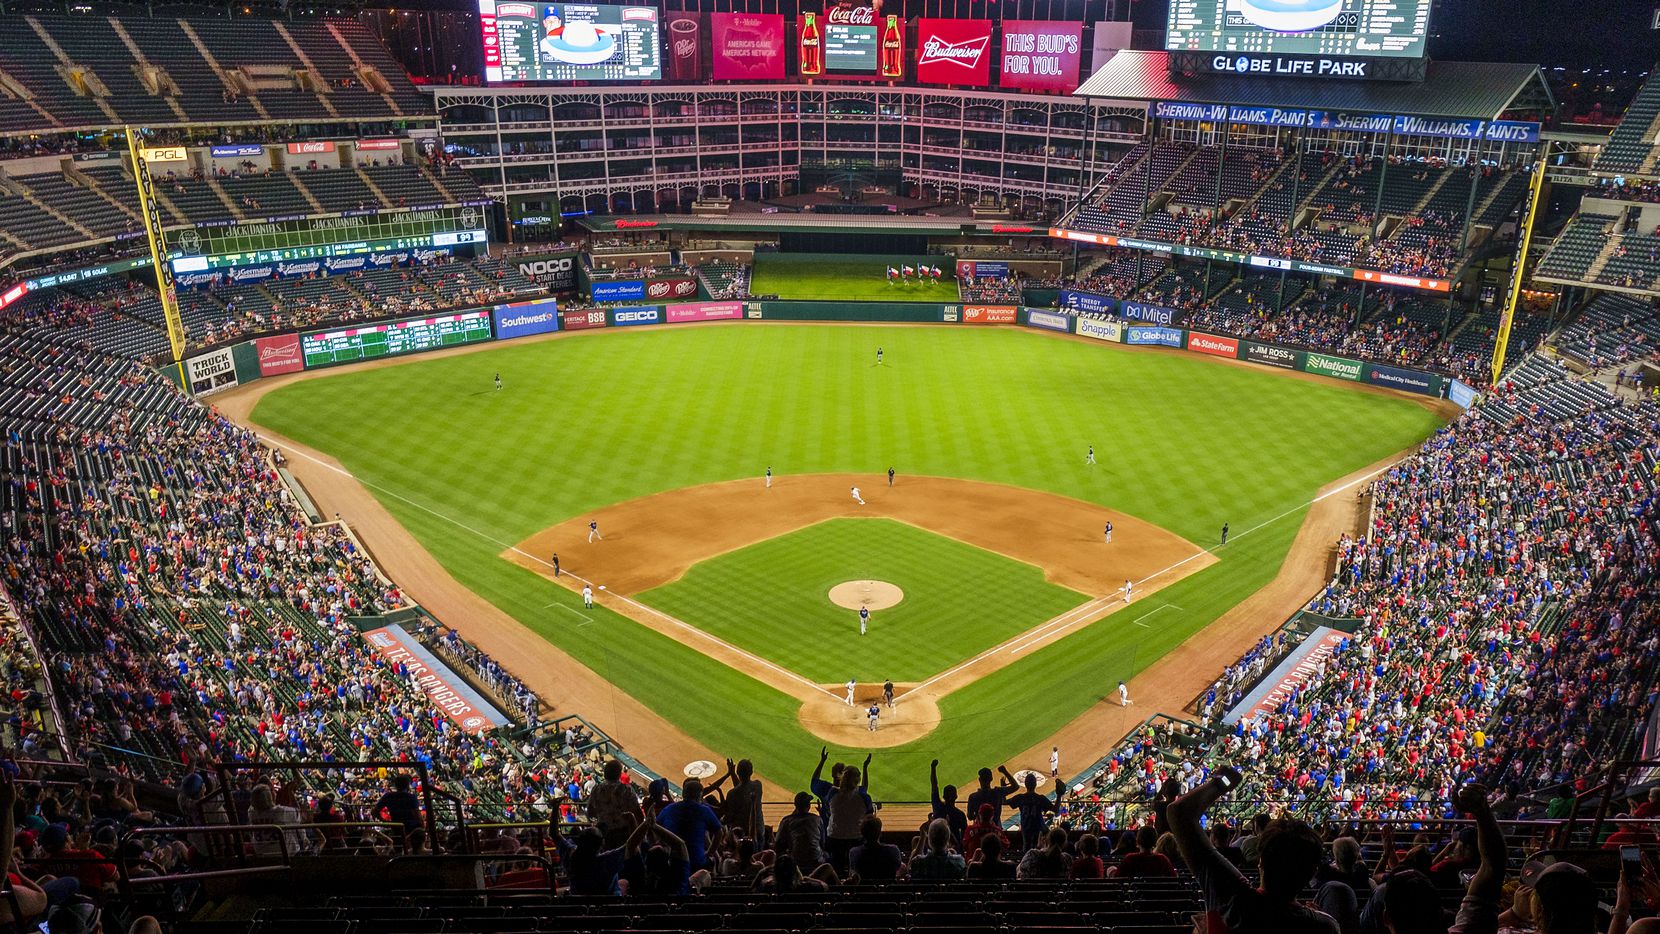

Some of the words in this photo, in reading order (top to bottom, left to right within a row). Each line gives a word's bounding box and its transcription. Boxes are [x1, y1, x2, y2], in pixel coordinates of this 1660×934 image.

[924, 41, 980, 58] Budweiser
[1005, 33, 1033, 52] THIS
[1037, 34, 1078, 54] BUD'S
[1004, 55, 1029, 73] FOR
[1032, 57, 1062, 75] YOU.
[1213, 56, 1271, 73] GLOBE
[1276, 57, 1312, 74] LIFE
[1319, 59, 1366, 76] PARK
[155, 150, 182, 160] PGL
[460, 233, 471, 241] 99
[519, 257, 573, 276] NOCO
[536, 273, 555, 282] START
[556, 271, 574, 280] DEAD
[1080, 297, 1101, 306] ENERGY
[501, 313, 547, 328] Southwest
[588, 312, 605, 324] BSB
[615, 310, 658, 322] GEICO
[1142, 307, 1172, 325] Mitel
[1081, 320, 1116, 337] Snapple
[1142, 330, 1165, 340] Globe
[1166, 332, 1180, 342] Life
[265, 347, 295, 357] Budweiser
[1255, 346, 1268, 355] JIM
[1269, 348, 1288, 359] ROSS
[193, 352, 229, 370] TRUCK
[1319, 359, 1361, 375] National
[194, 361, 231, 380] WORLD
[1341, 371, 1357, 379] Rental
[1379, 373, 1395, 381] Medical
[1404, 378, 1429, 388] Healthcare
[387, 647, 427, 674] TEXAS
[1292, 643, 1334, 684] RANGERS
[420, 674, 471, 716] RANGERS
[1262, 678, 1297, 707] TEXAS
